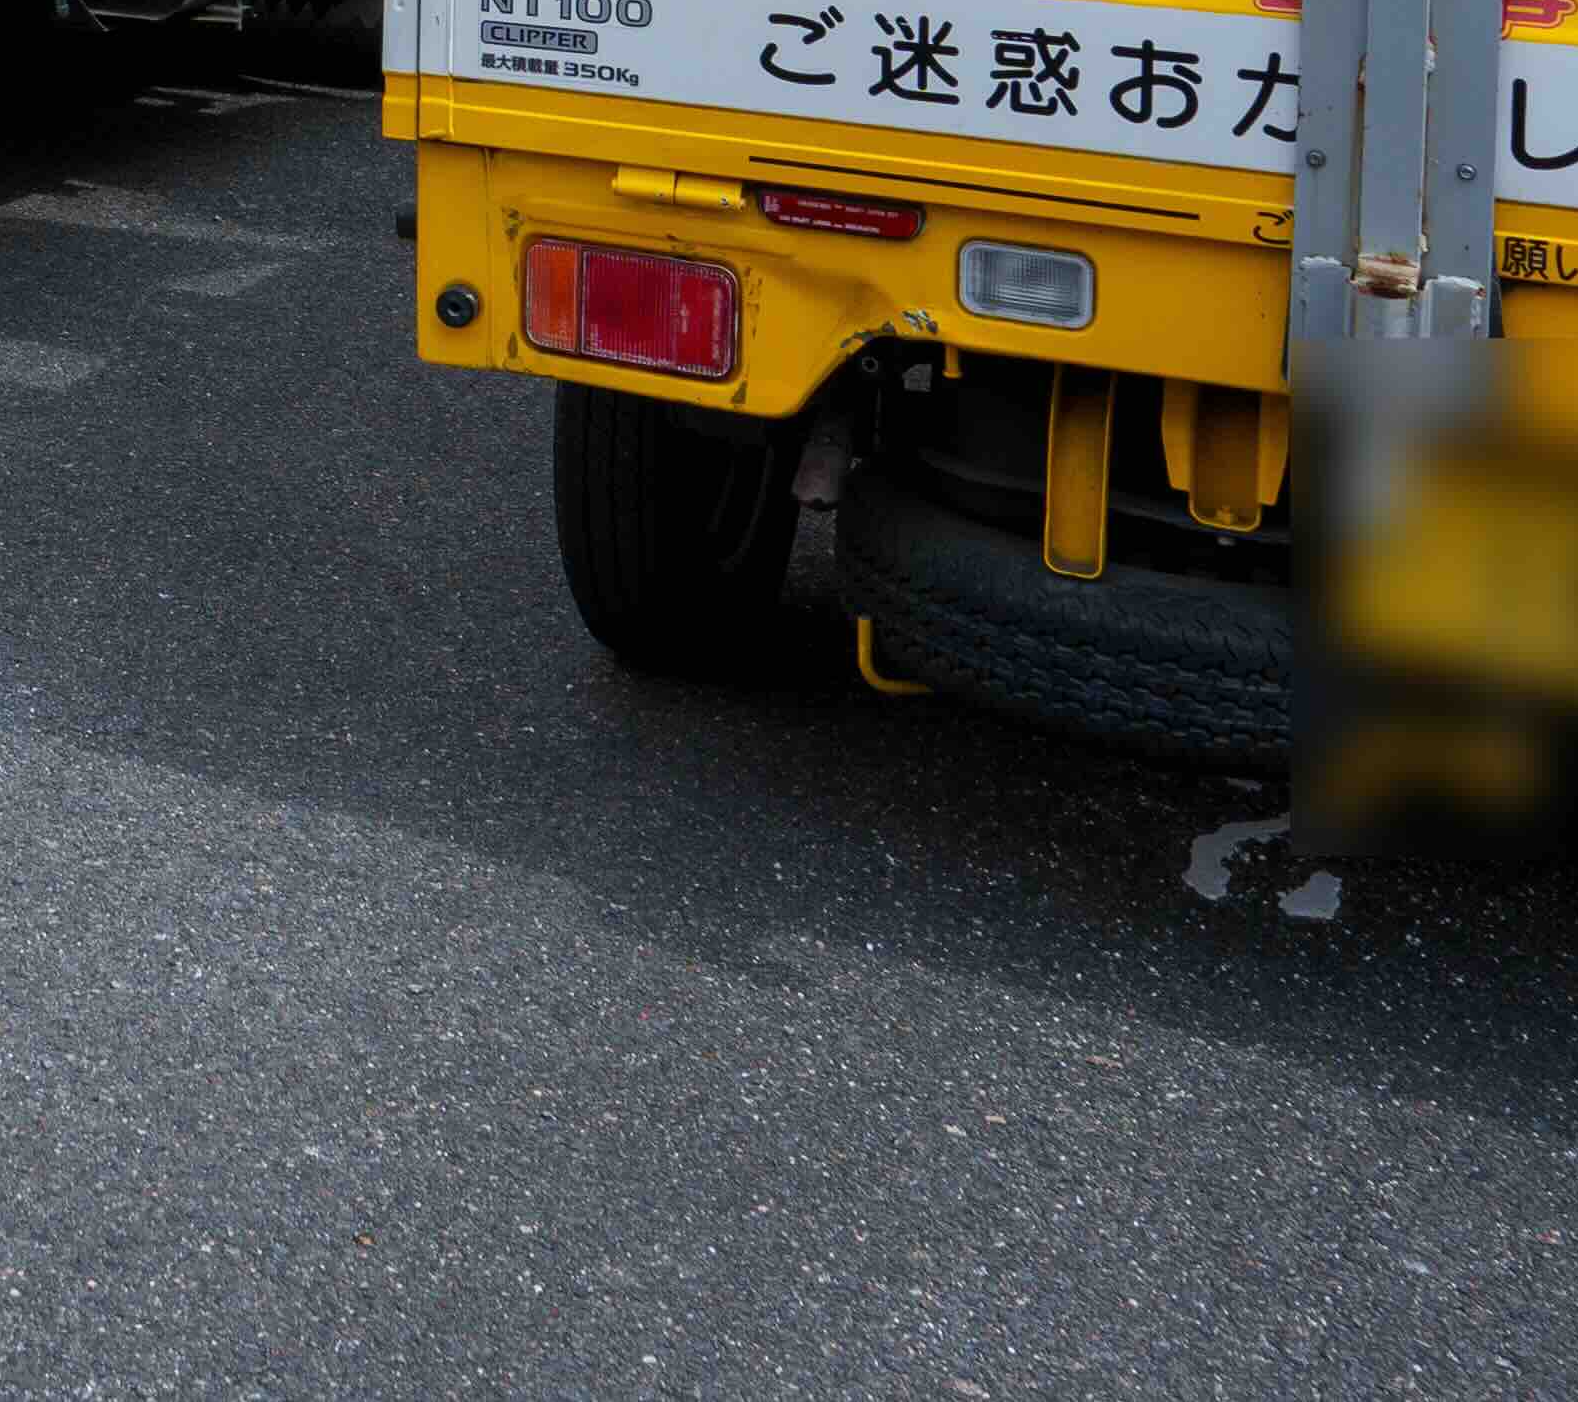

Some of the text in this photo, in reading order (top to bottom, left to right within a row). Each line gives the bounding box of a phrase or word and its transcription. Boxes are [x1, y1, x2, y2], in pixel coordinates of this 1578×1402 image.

[490, 25, 588, 50] CLIPPER
[481, 53, 639, 86] 最大積載量 350Kg
